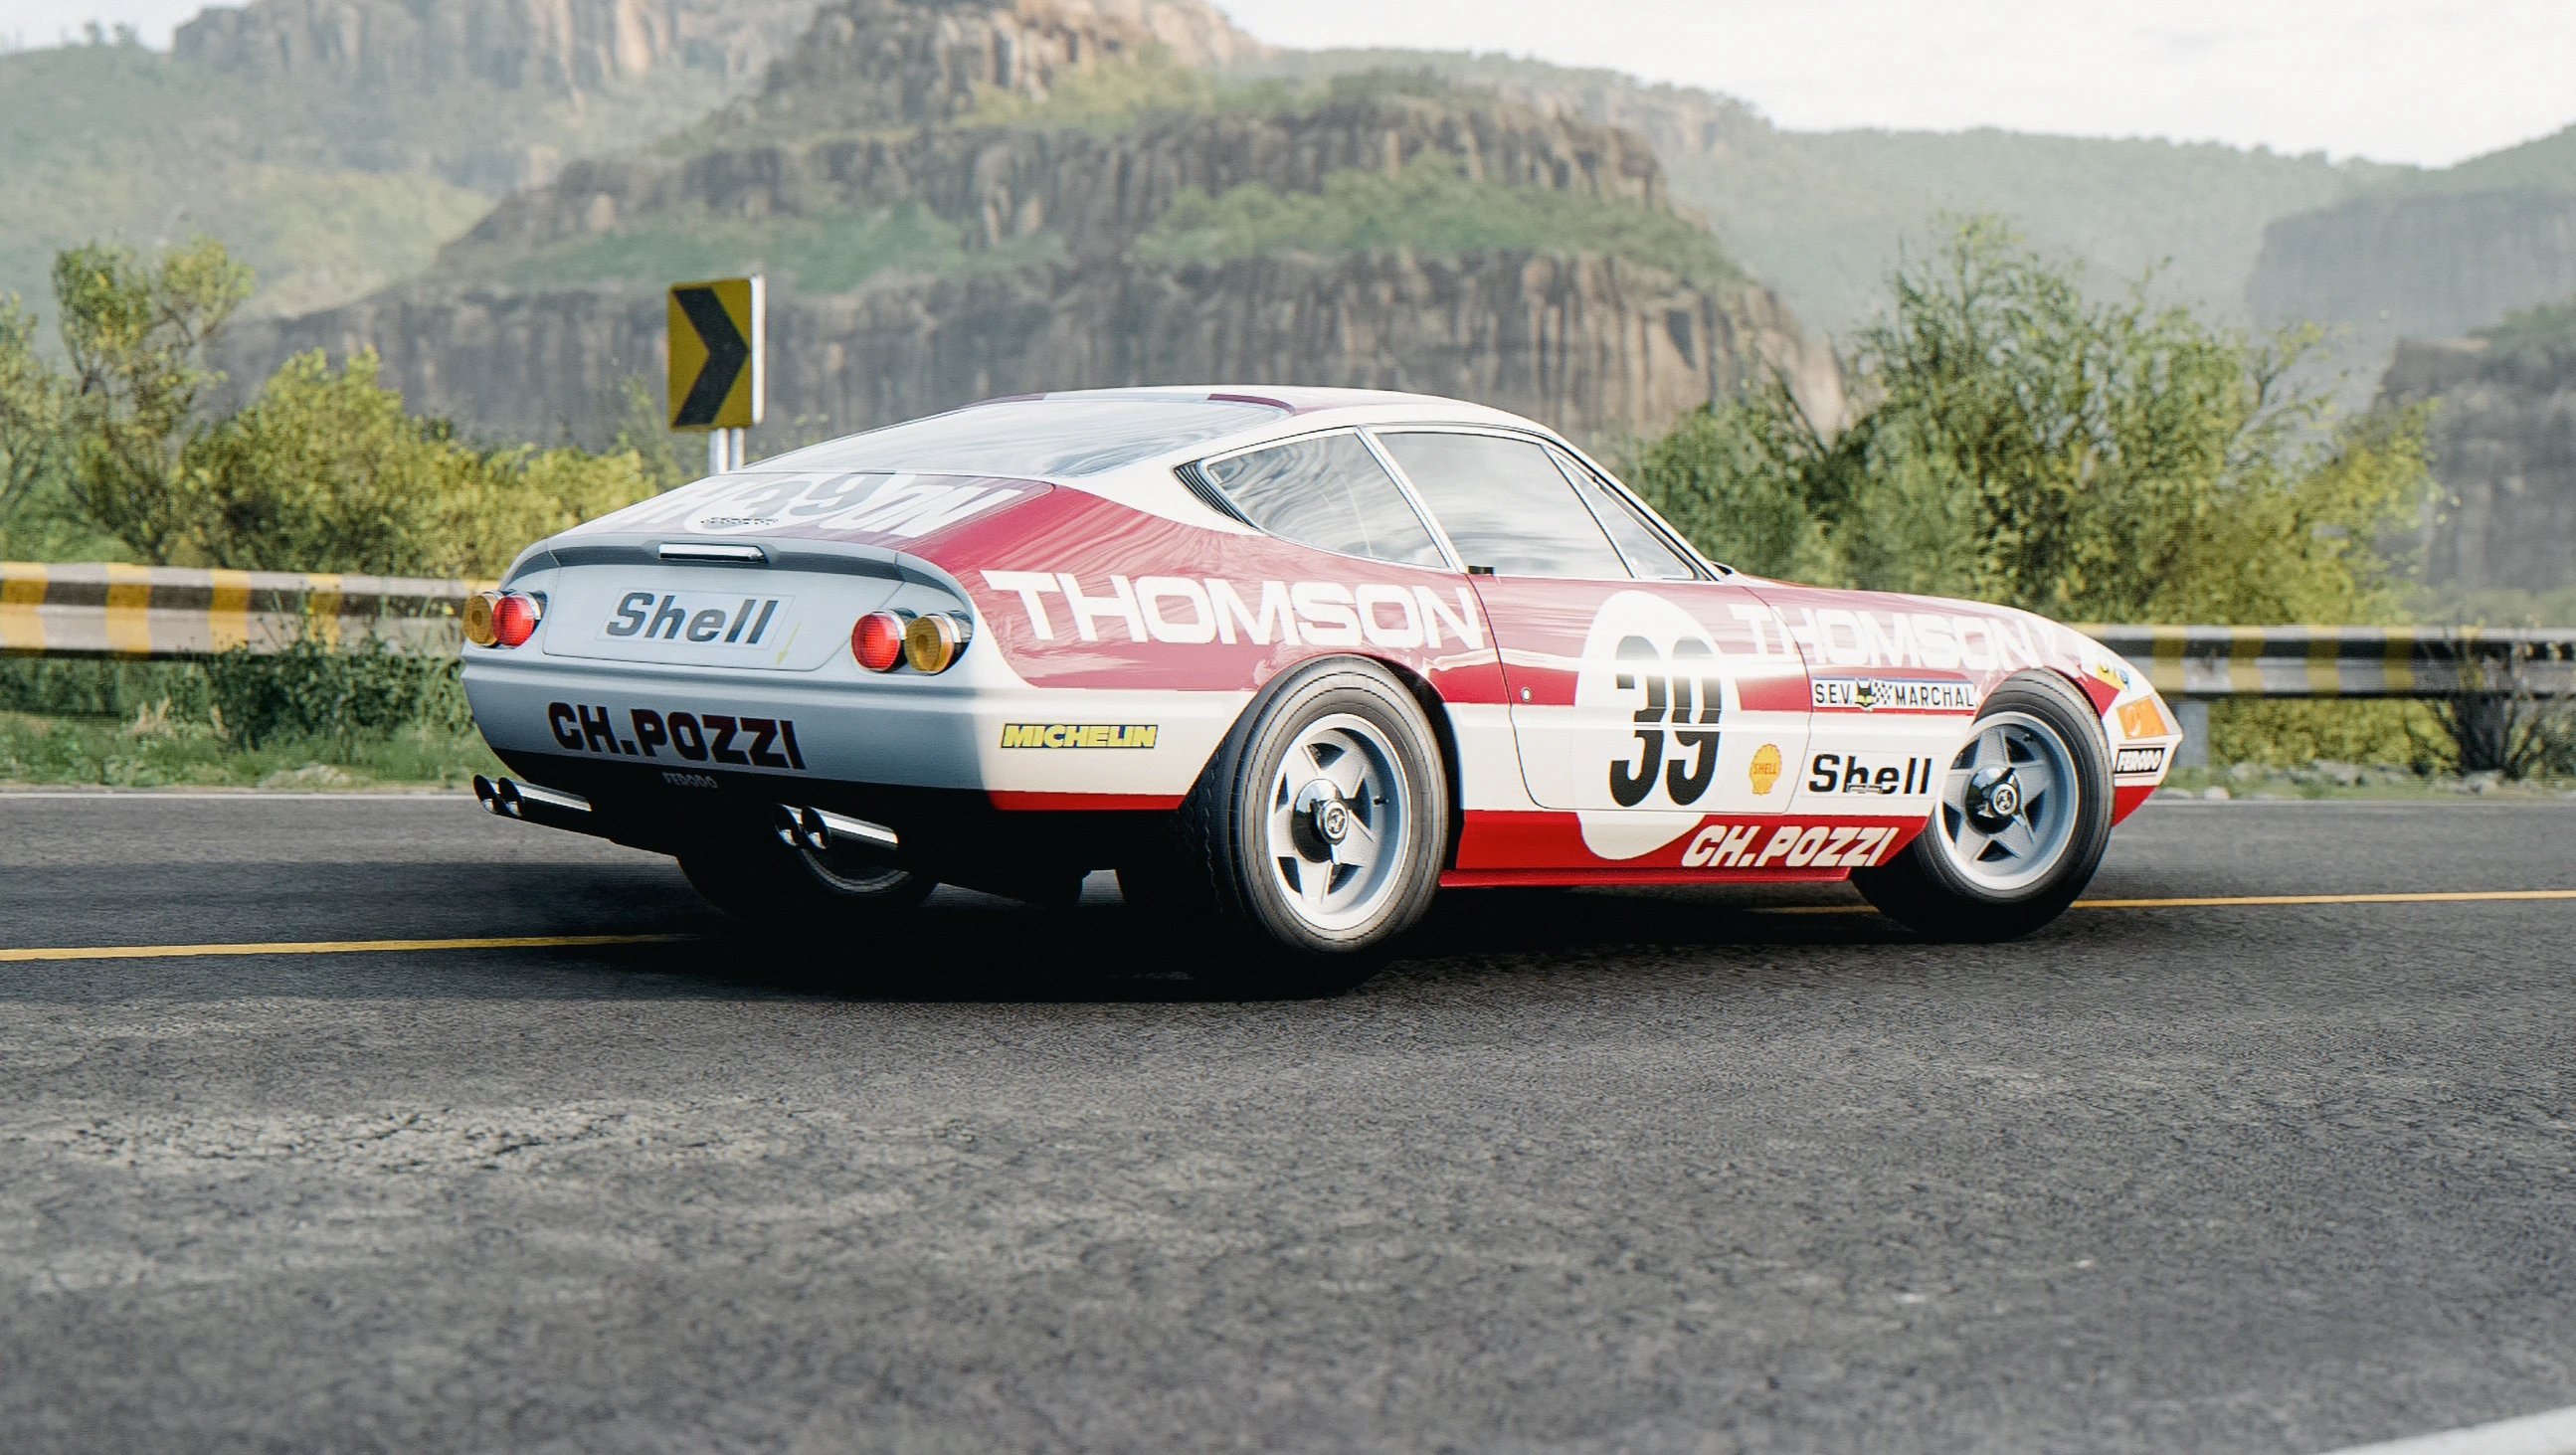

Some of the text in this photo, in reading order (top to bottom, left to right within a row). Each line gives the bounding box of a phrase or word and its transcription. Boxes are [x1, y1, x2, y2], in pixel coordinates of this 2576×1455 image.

[606, 592, 779, 644] Shell
[980, 570, 1484, 649] THOMSON
[1729, 603, 2041, 671] THOMSON
[1895, 685, 1974, 707] MARCHAL
[548, 702, 807, 770] CH.POZZI
[1003, 725, 1157, 748] MICHELIN
[1609, 635, 1722, 808] 39
[1753, 763, 1777, 775] SHELL
[1808, 754, 1932, 795] Shell
[2116, 749, 2162, 772] FERODO
[1681, 824, 1901, 867] CH.POZZI
